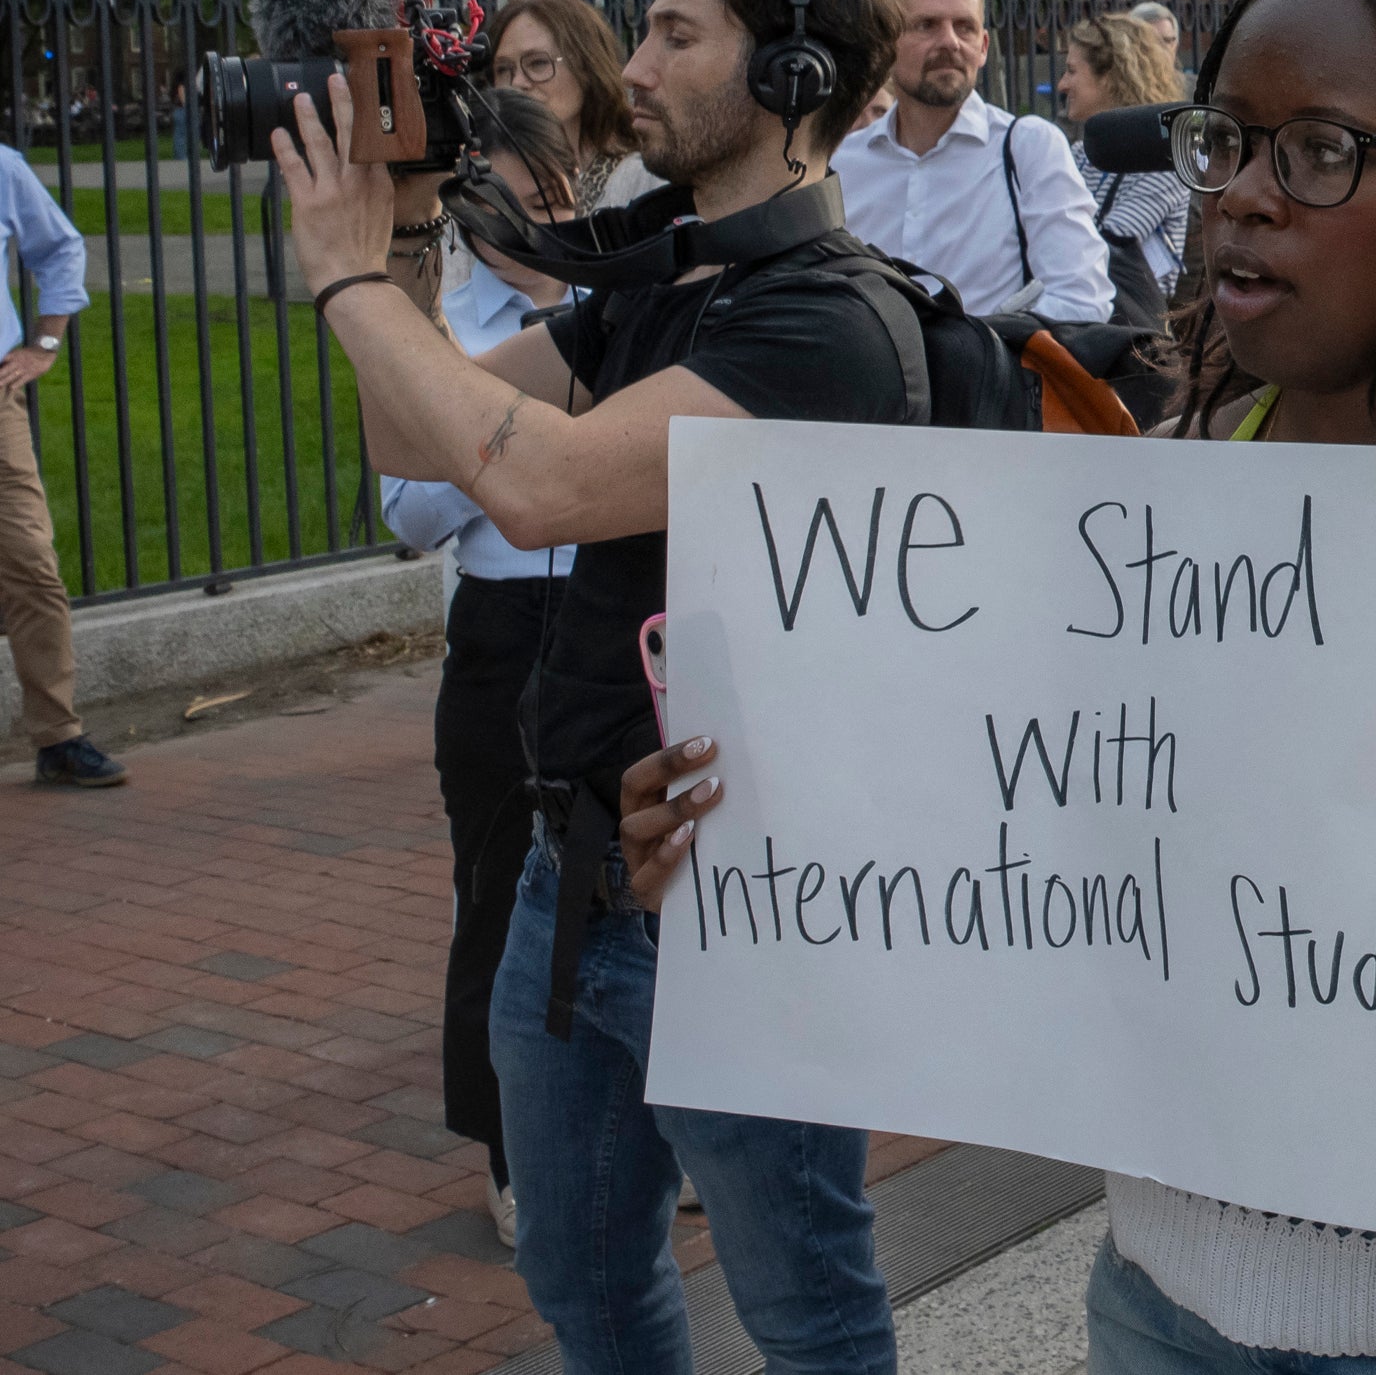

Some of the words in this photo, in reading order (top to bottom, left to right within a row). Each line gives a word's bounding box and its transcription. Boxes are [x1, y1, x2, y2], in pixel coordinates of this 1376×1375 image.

[750, 480, 981, 634] We
[1065, 493, 1326, 648] Stand
[689, 820, 1171, 983] International
